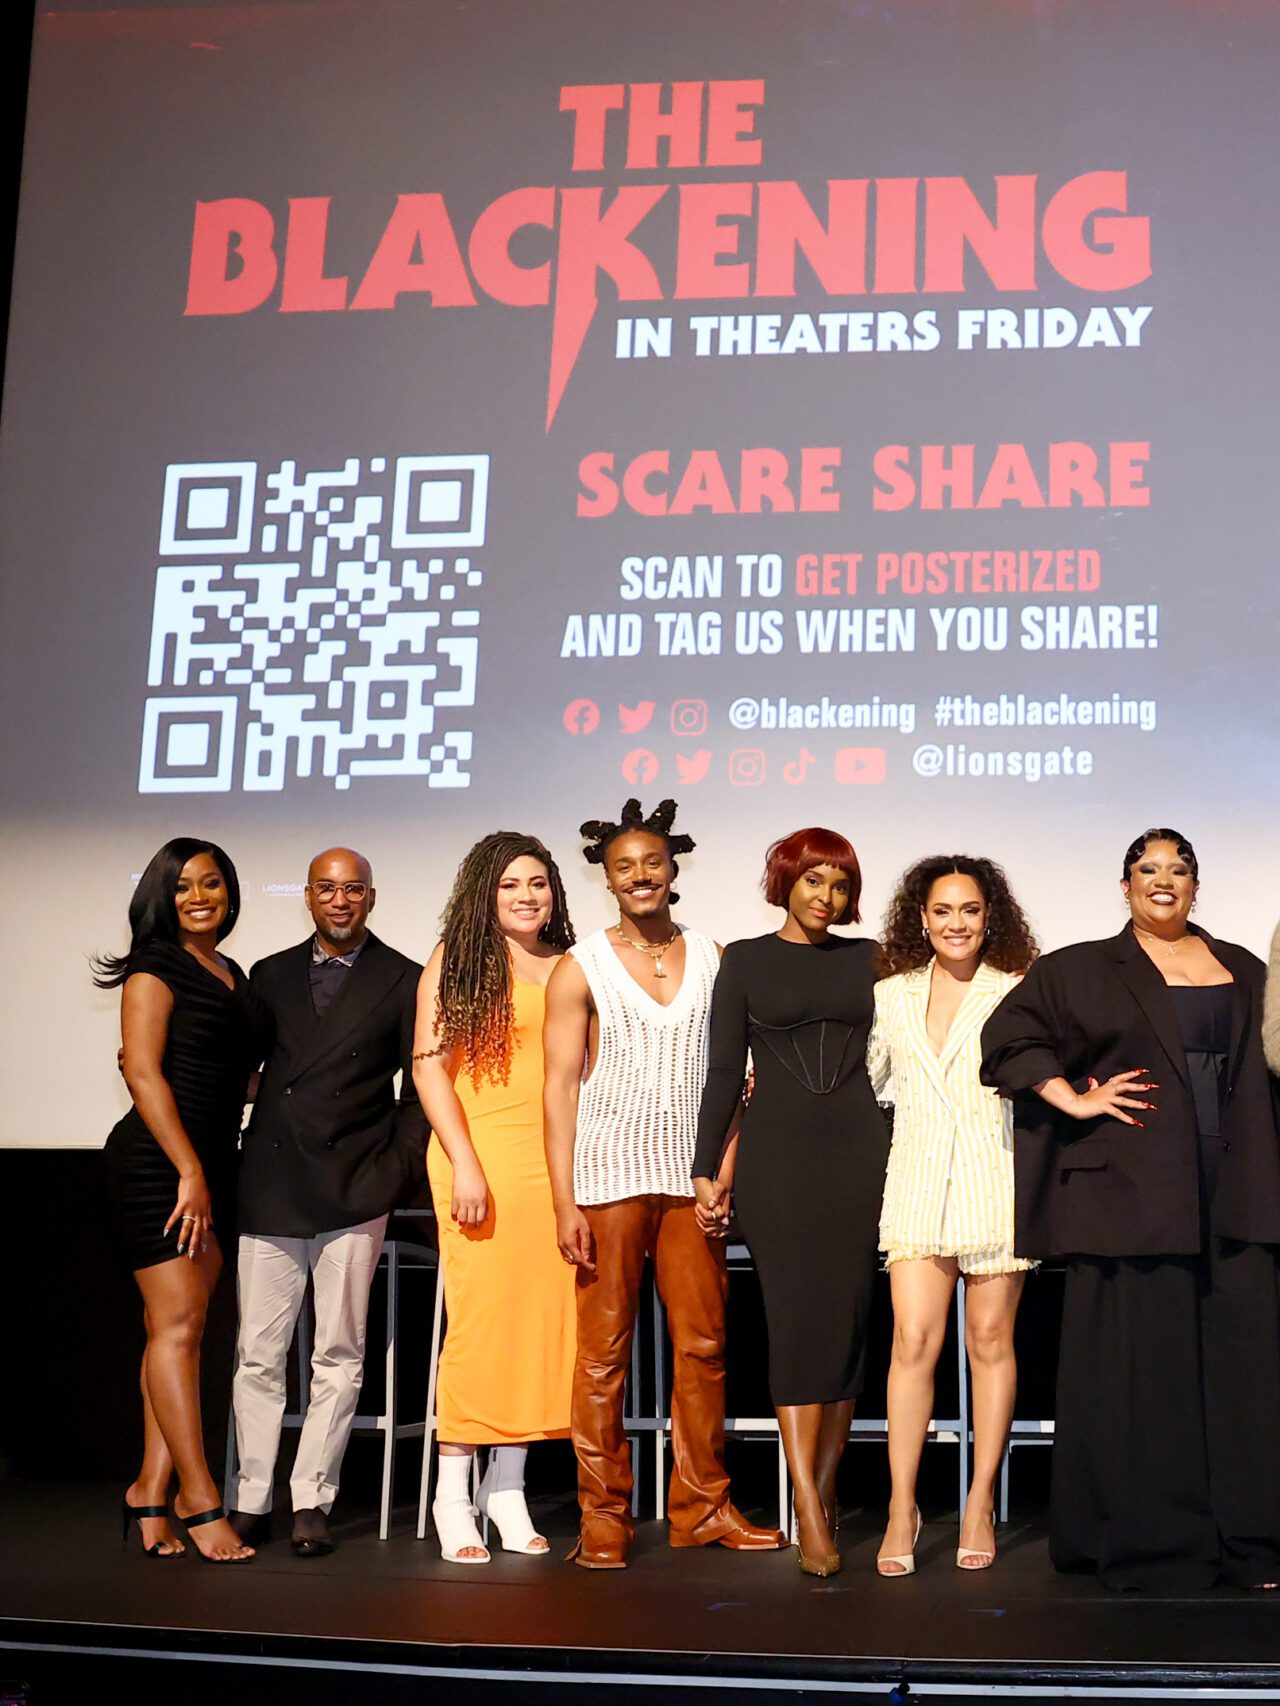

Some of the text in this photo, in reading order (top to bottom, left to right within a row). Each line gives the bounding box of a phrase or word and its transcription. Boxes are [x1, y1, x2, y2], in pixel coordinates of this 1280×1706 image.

[560, 80, 765, 171] THE
[184, 170, 1152, 432] BLACKENING
[616, 307, 1153, 358] IN THEATERS FRIDAY
[577, 442, 1151, 518] SCARE SHARE
[621, 549, 1101, 600] SCAN TO GET POSTERIZED
[561, 605, 1157, 657] AND TAG US WHEN YOU SHARE!
[729, 694, 1155, 734] @blackening #theblackening
[913, 745, 1092, 782] @lionsgate
[262, 883, 306, 893] LIONSGA
